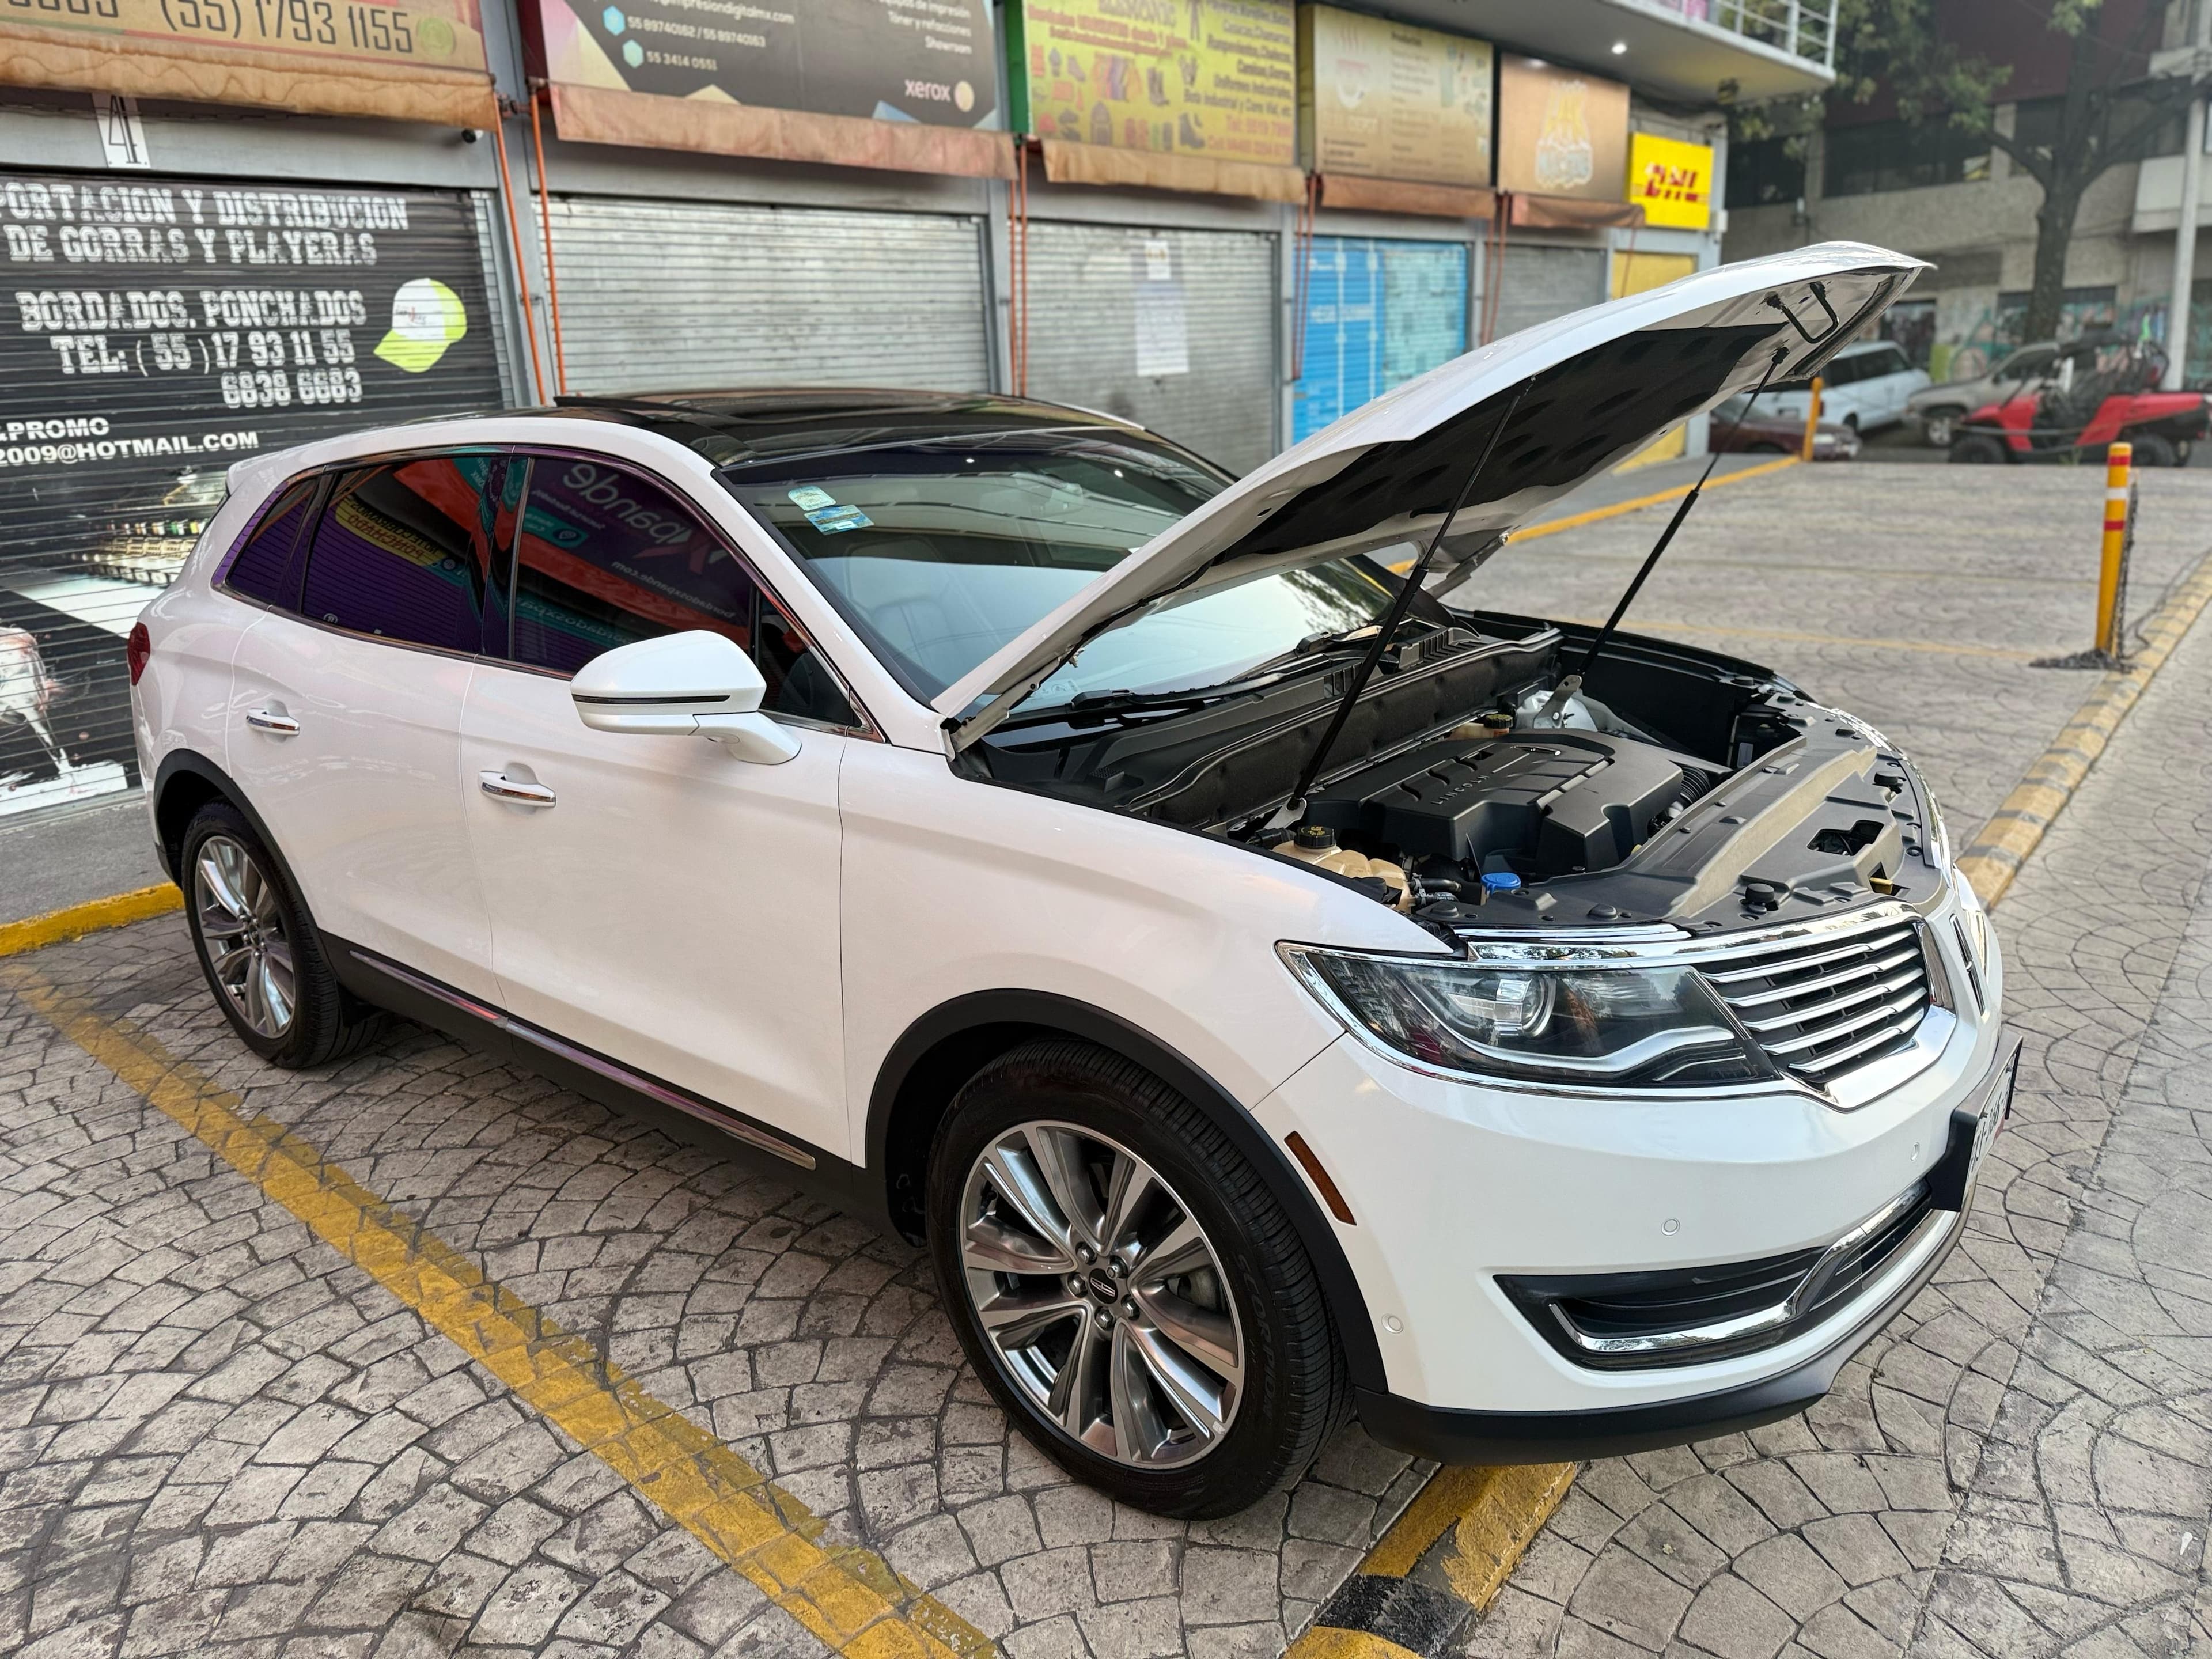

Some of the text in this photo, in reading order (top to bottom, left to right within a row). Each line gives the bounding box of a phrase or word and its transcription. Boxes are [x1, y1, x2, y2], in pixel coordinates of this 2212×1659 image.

[255, 0, 336, 44] 1793
[347, 6, 413, 53] 1155
[904, 79, 951, 103] xerox
[109, 94, 142, 165] 4
[181, 189, 204, 224] Y
[212, 191, 410, 230] DISTRIBUCION
[3, 224, 378, 266] DE GORRAS Y PLAYERAS
[199, 290, 367, 327] PONCHADOS
[50, 335, 129, 374] TEL:
[248, 331, 285, 367] 93
[290, 331, 317, 365] 11
[320, 329, 356, 364] 55
[221, 368, 363, 408] 6838 6683
